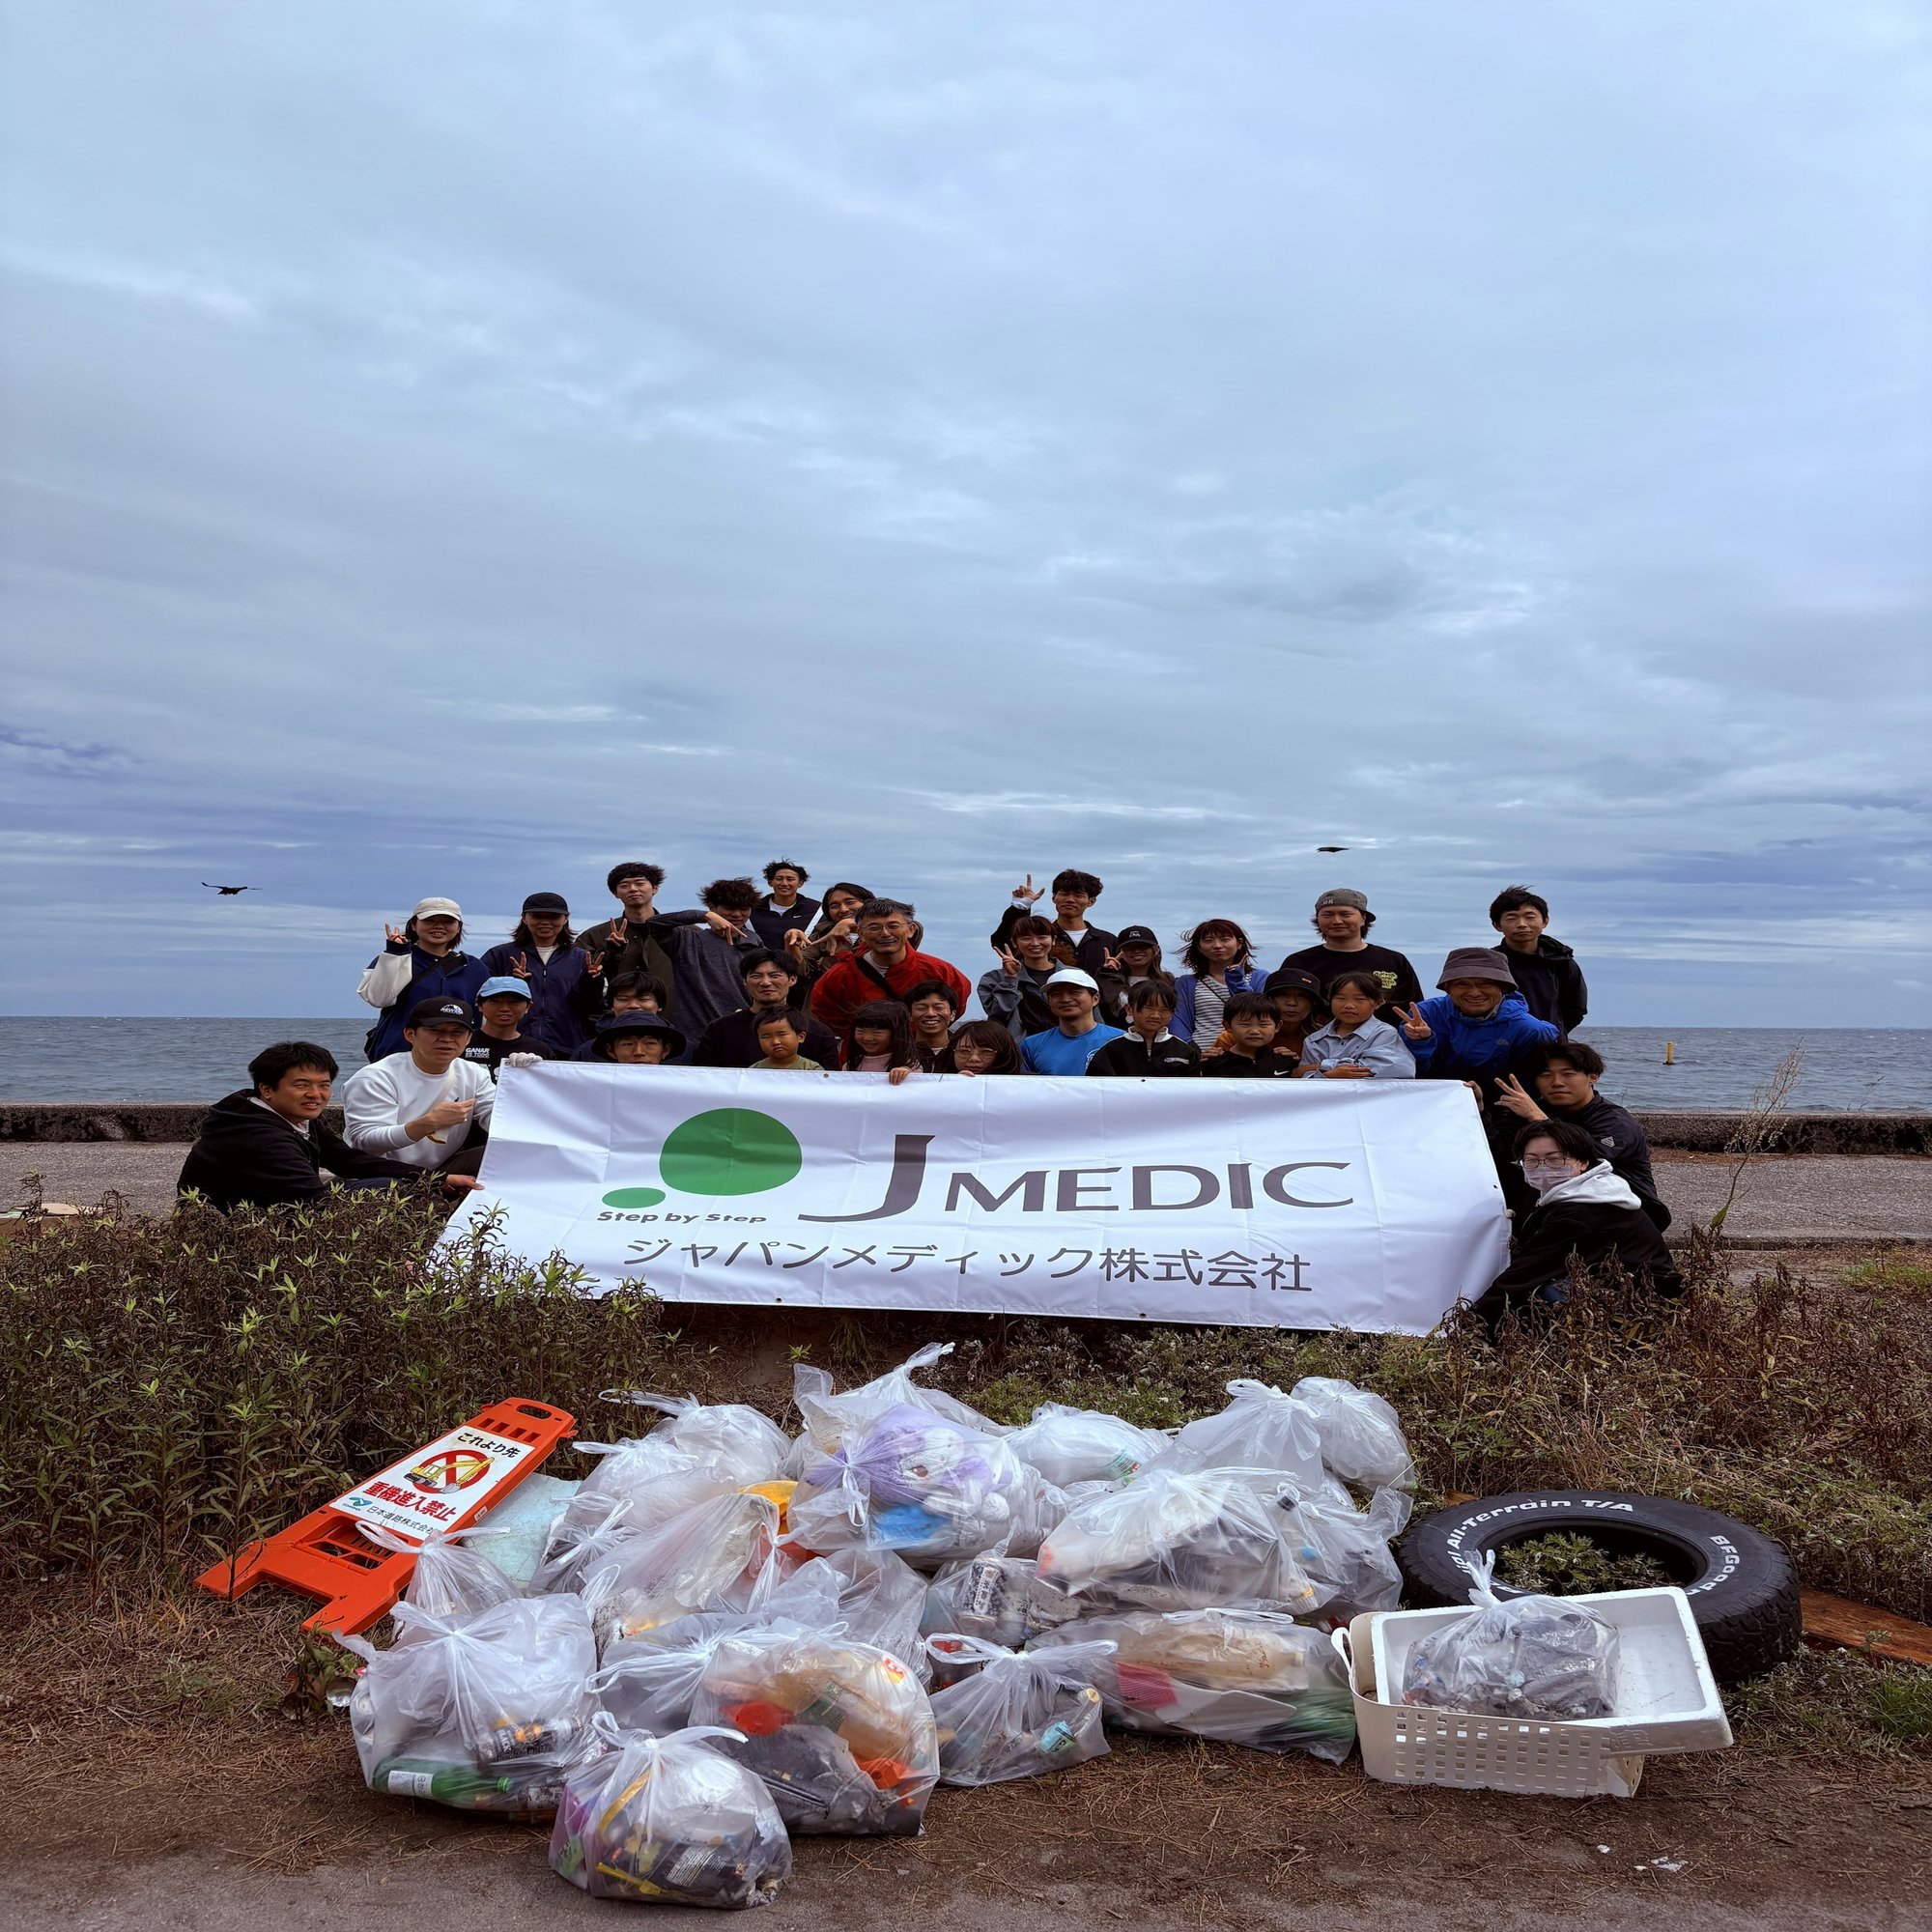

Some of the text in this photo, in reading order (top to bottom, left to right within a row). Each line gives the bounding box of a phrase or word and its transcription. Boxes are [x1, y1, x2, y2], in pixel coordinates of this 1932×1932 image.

[597, 1211, 767, 1224] Step by Step
[624, 1238, 1312, 1293] ジャパンメディック株式会社
[457, 1432, 522, 1459] これより先
[362, 1481, 457, 1522] 重機進入禁止
[1447, 1500, 1572, 1550] All-Terrain
[1581, 1499, 1634, 1512] T/A
[1686, 1536, 1740, 1595] BFGoodr
